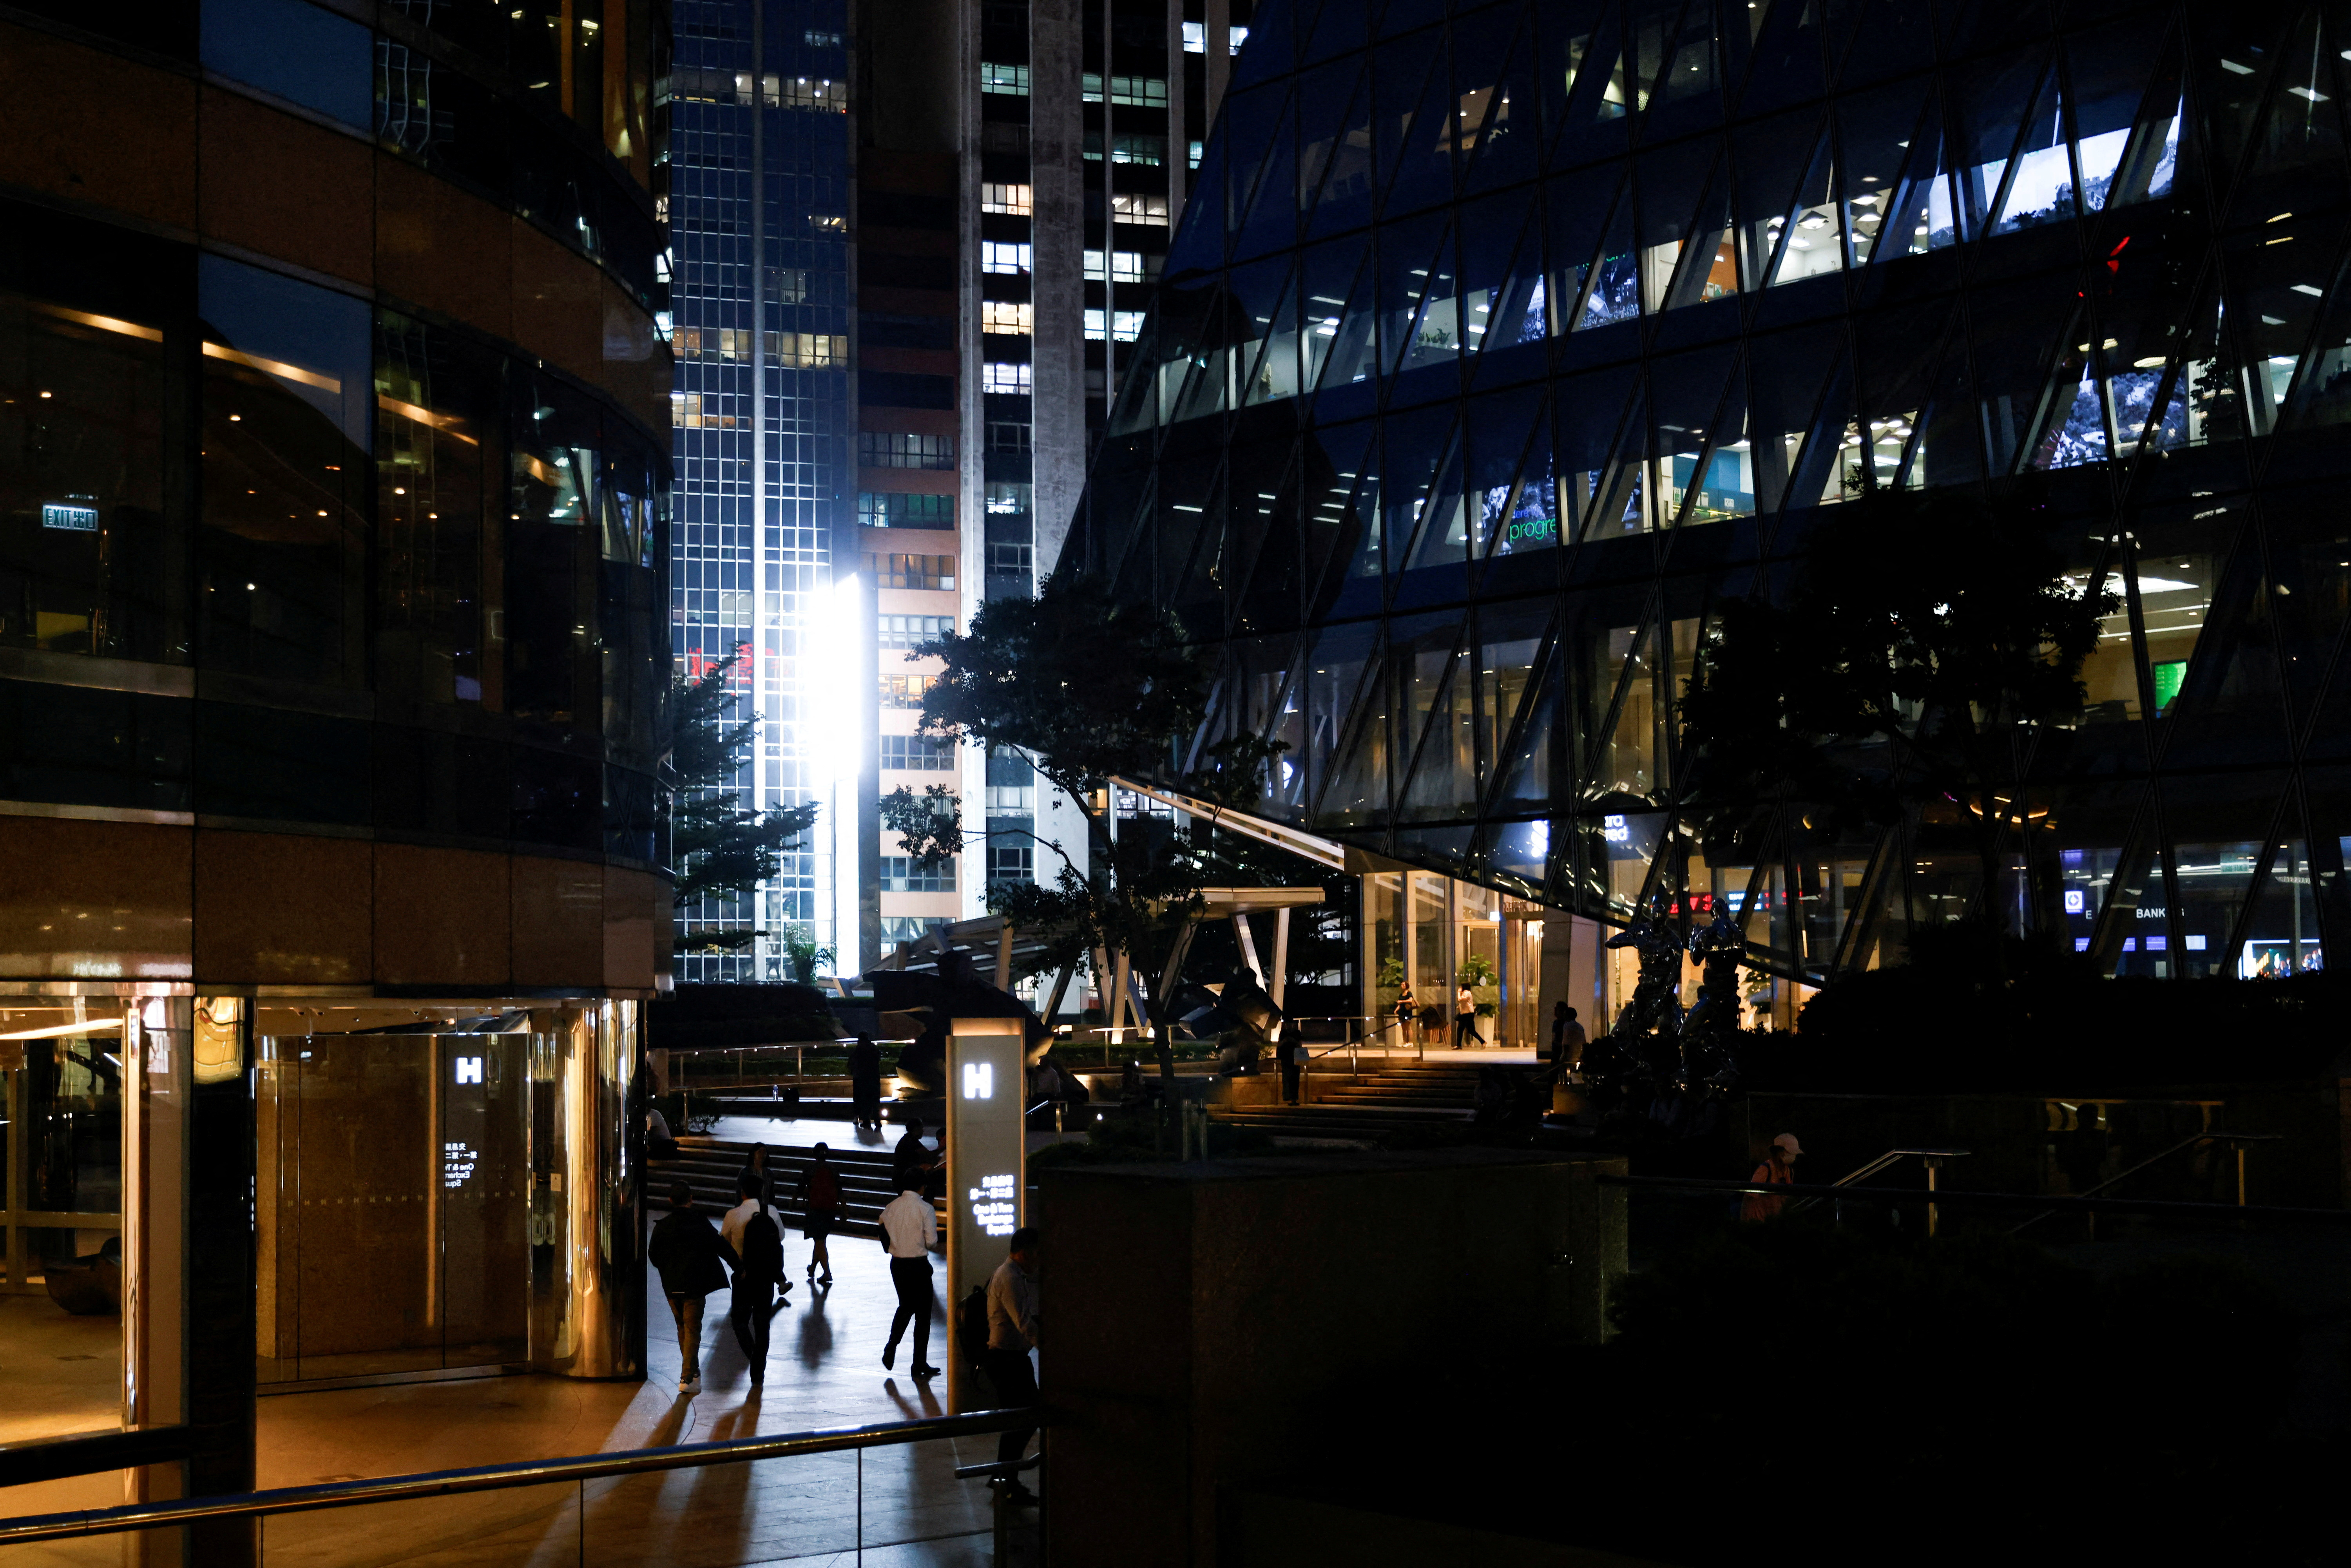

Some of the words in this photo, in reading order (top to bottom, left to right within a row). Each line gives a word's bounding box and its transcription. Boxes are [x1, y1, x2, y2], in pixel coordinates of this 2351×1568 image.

[46, 509, 71, 527] EXIT
[74, 511, 95, 529] 出口
[1510, 518, 1556, 544] progre
[964, 1063, 992, 1099] H
[973, 1204, 990, 1215] One
